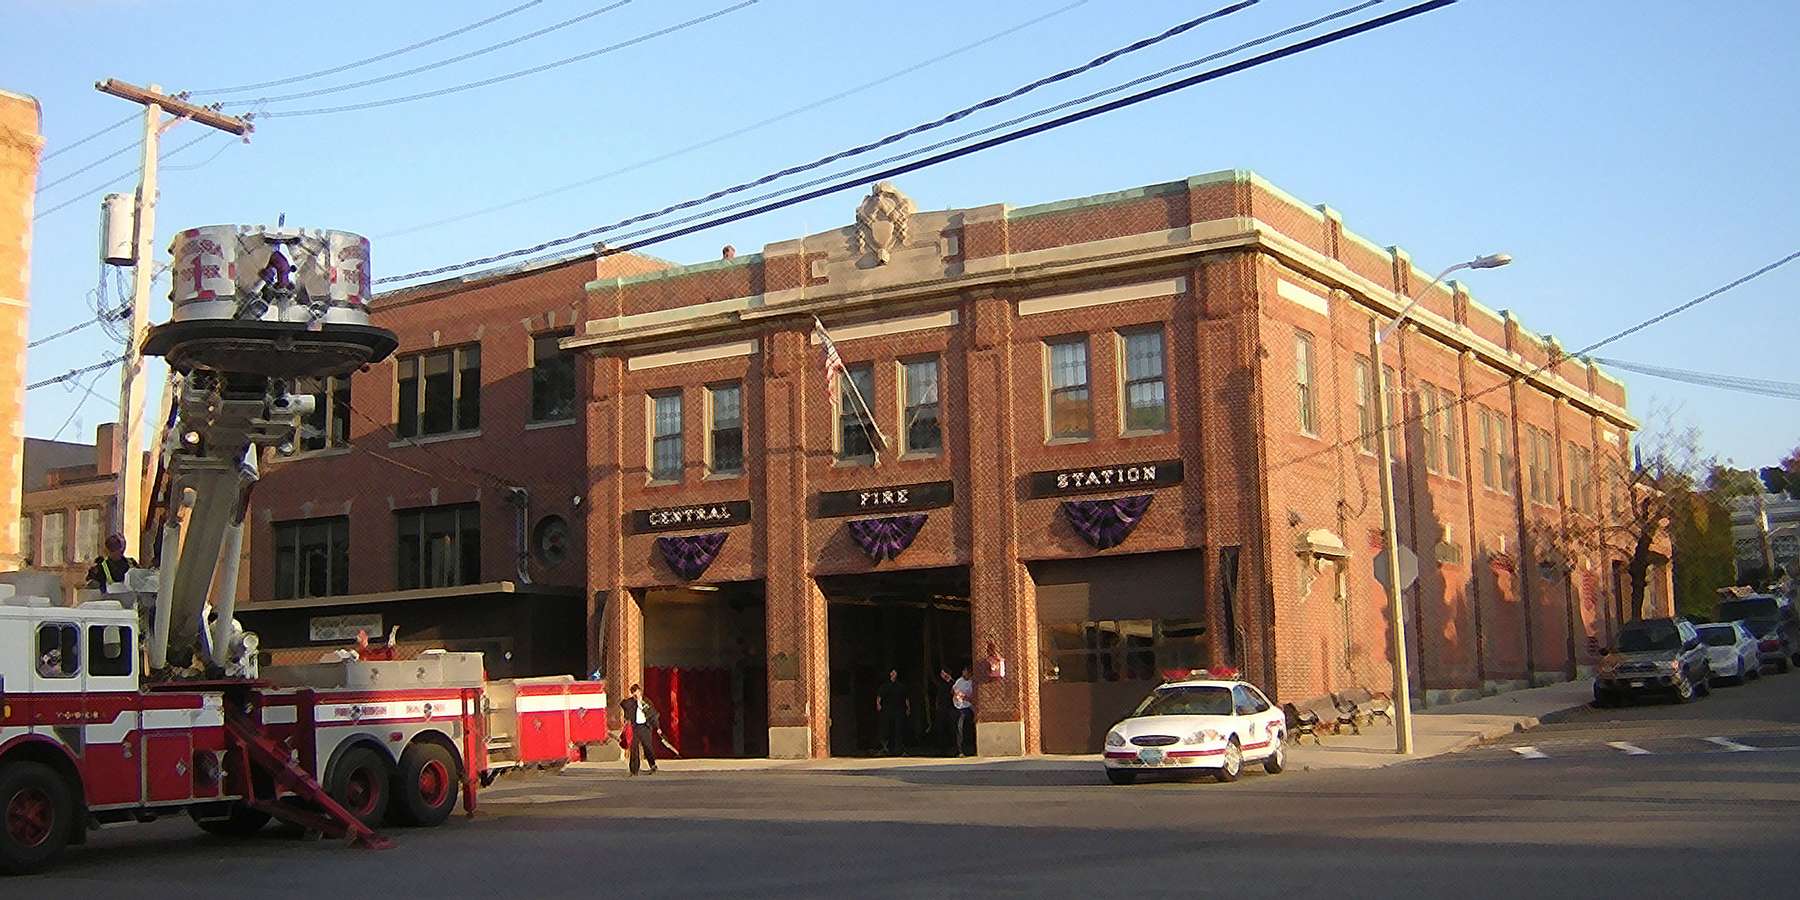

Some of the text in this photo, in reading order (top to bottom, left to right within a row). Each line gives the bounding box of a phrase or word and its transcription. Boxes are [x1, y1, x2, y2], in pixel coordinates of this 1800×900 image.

[1057, 465, 1156, 488] STATION
[860, 489, 908, 506] FIRE
[649, 505, 731, 526] CENTRAL
